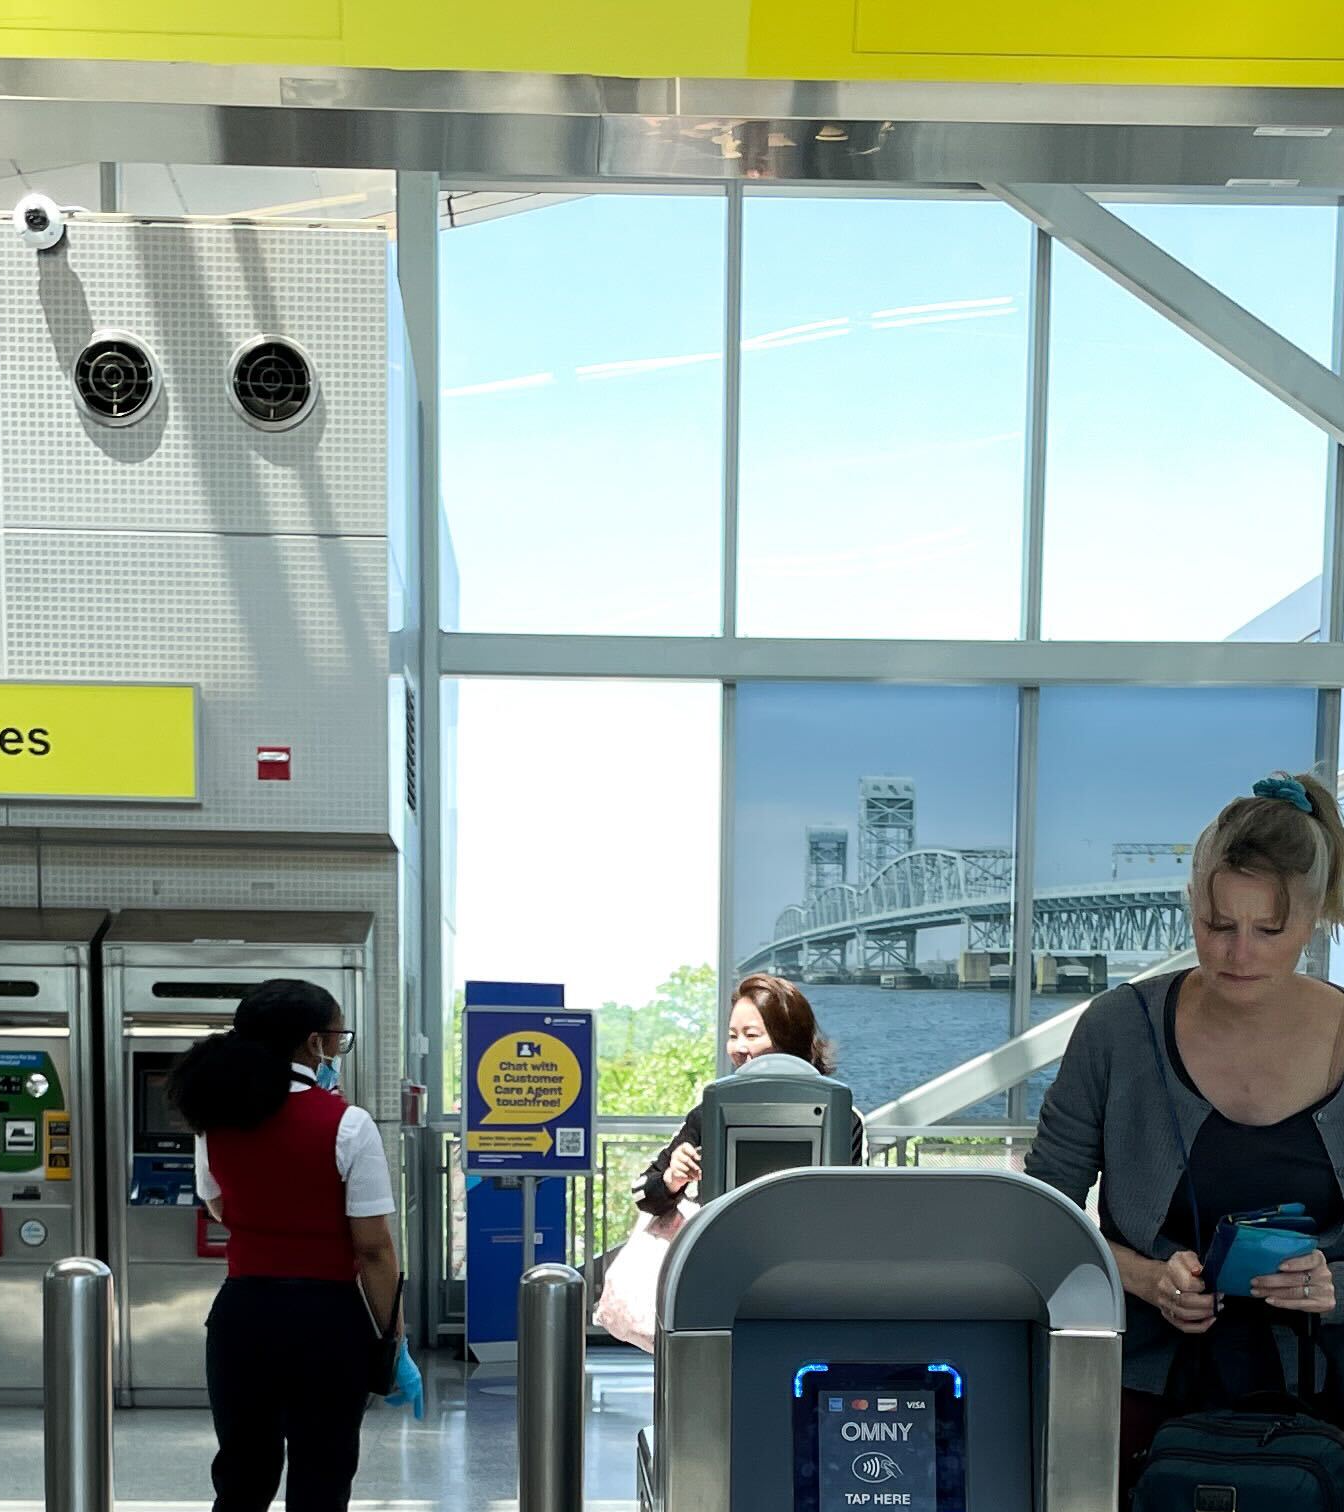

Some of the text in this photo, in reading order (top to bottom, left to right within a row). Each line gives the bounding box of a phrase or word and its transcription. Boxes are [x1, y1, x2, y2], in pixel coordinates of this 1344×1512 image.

[499, 1060, 558, 1072] Chat with
[493, 1074, 564, 1084] a Customer
[494, 1085, 563, 1100] Care Agent
[496, 1097, 561, 1108] touchfree!
[906, 1400, 926, 1409] VISA
[841, 1421, 913, 1442] OMNY
[844, 1493, 911, 1505] TAP HERE
